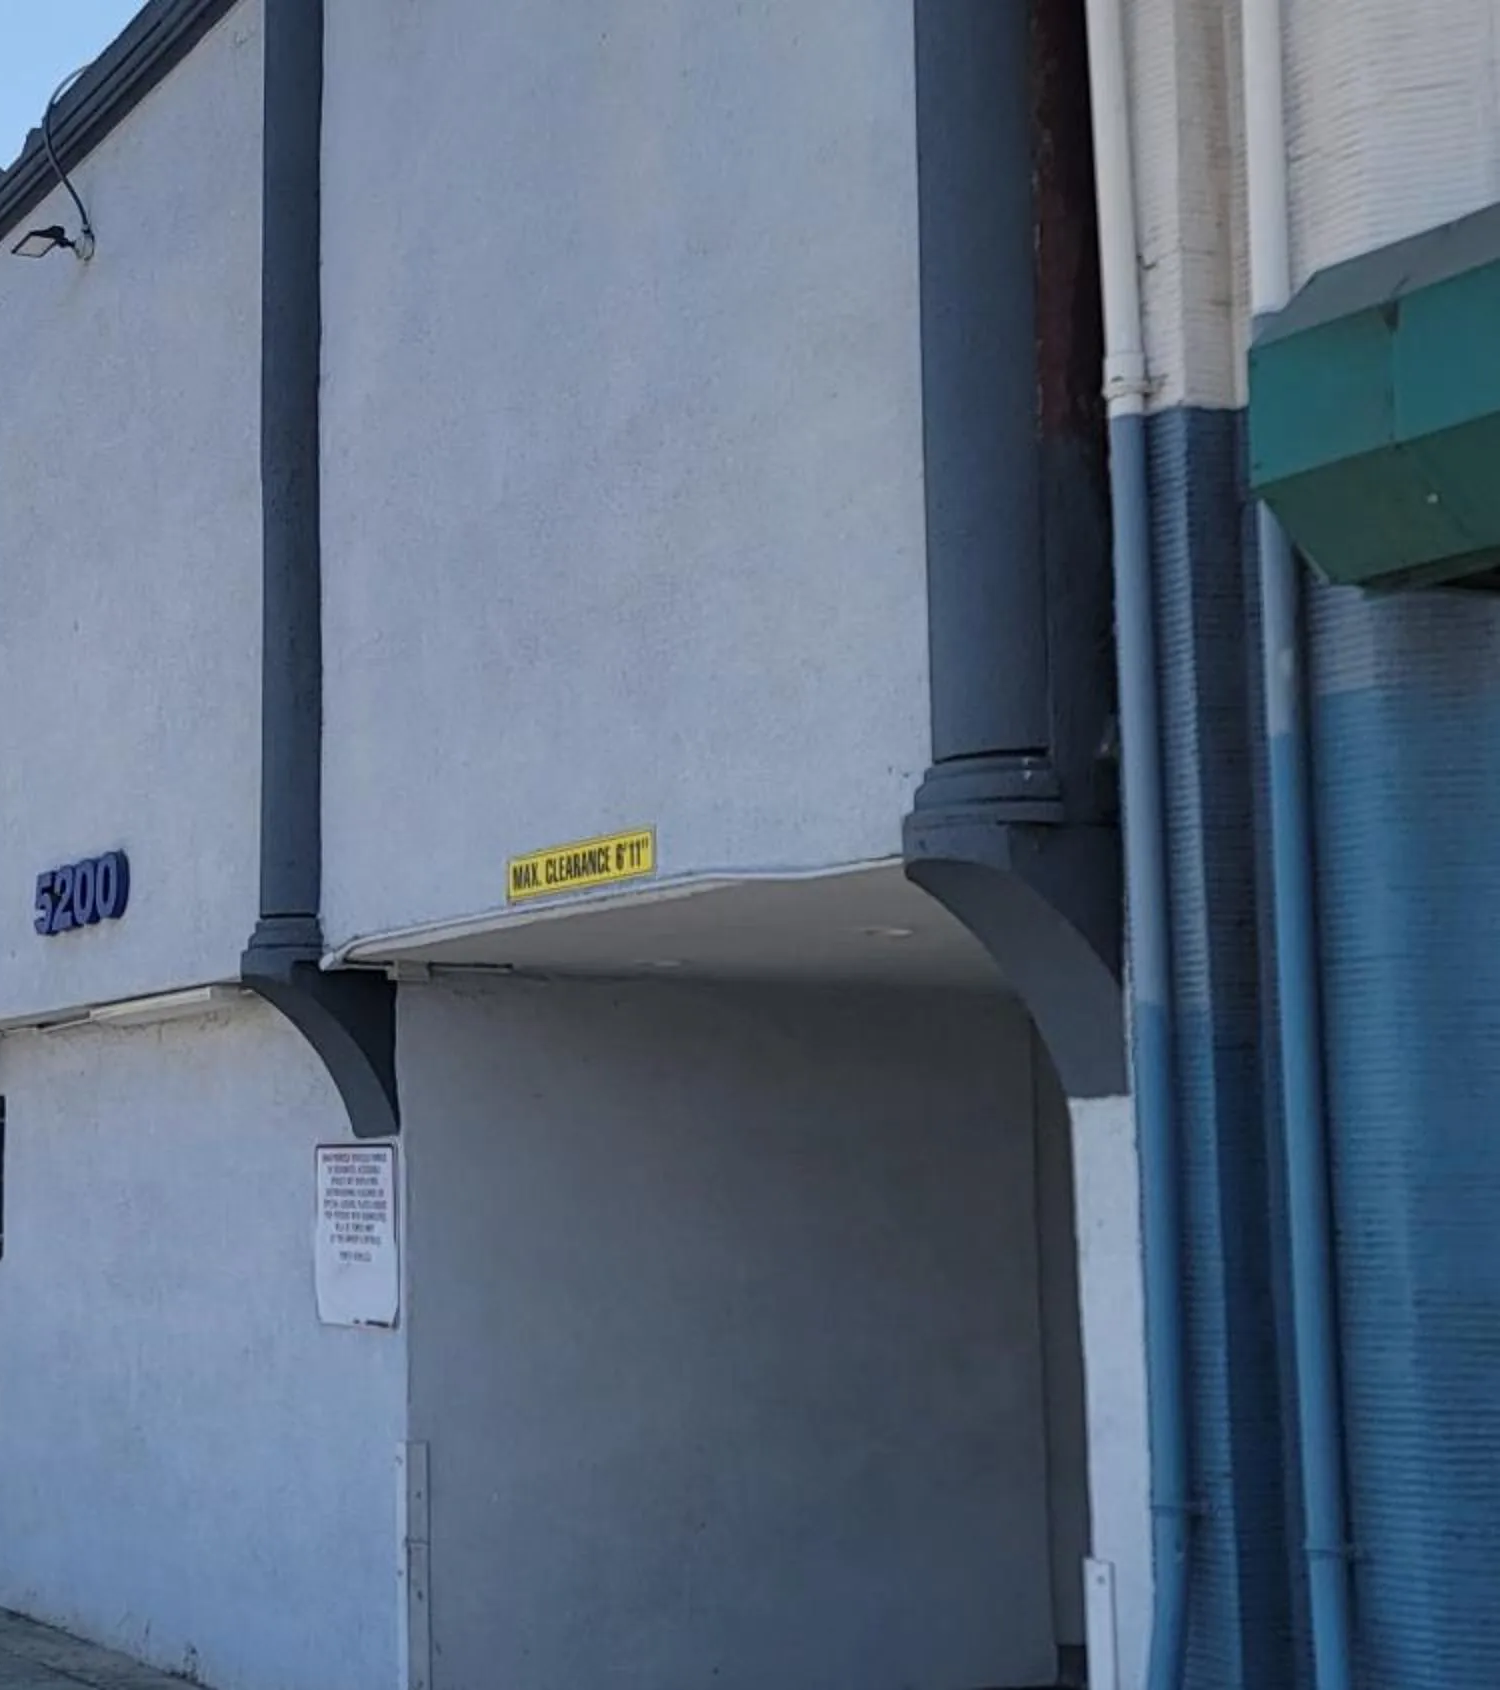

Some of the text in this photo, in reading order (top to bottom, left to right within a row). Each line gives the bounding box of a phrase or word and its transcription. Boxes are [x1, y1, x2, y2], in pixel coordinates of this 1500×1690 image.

[33, 849, 130, 936] 5200
[512, 862, 542, 891] MAX.
[545, 845, 611, 885] CLEARANCE
